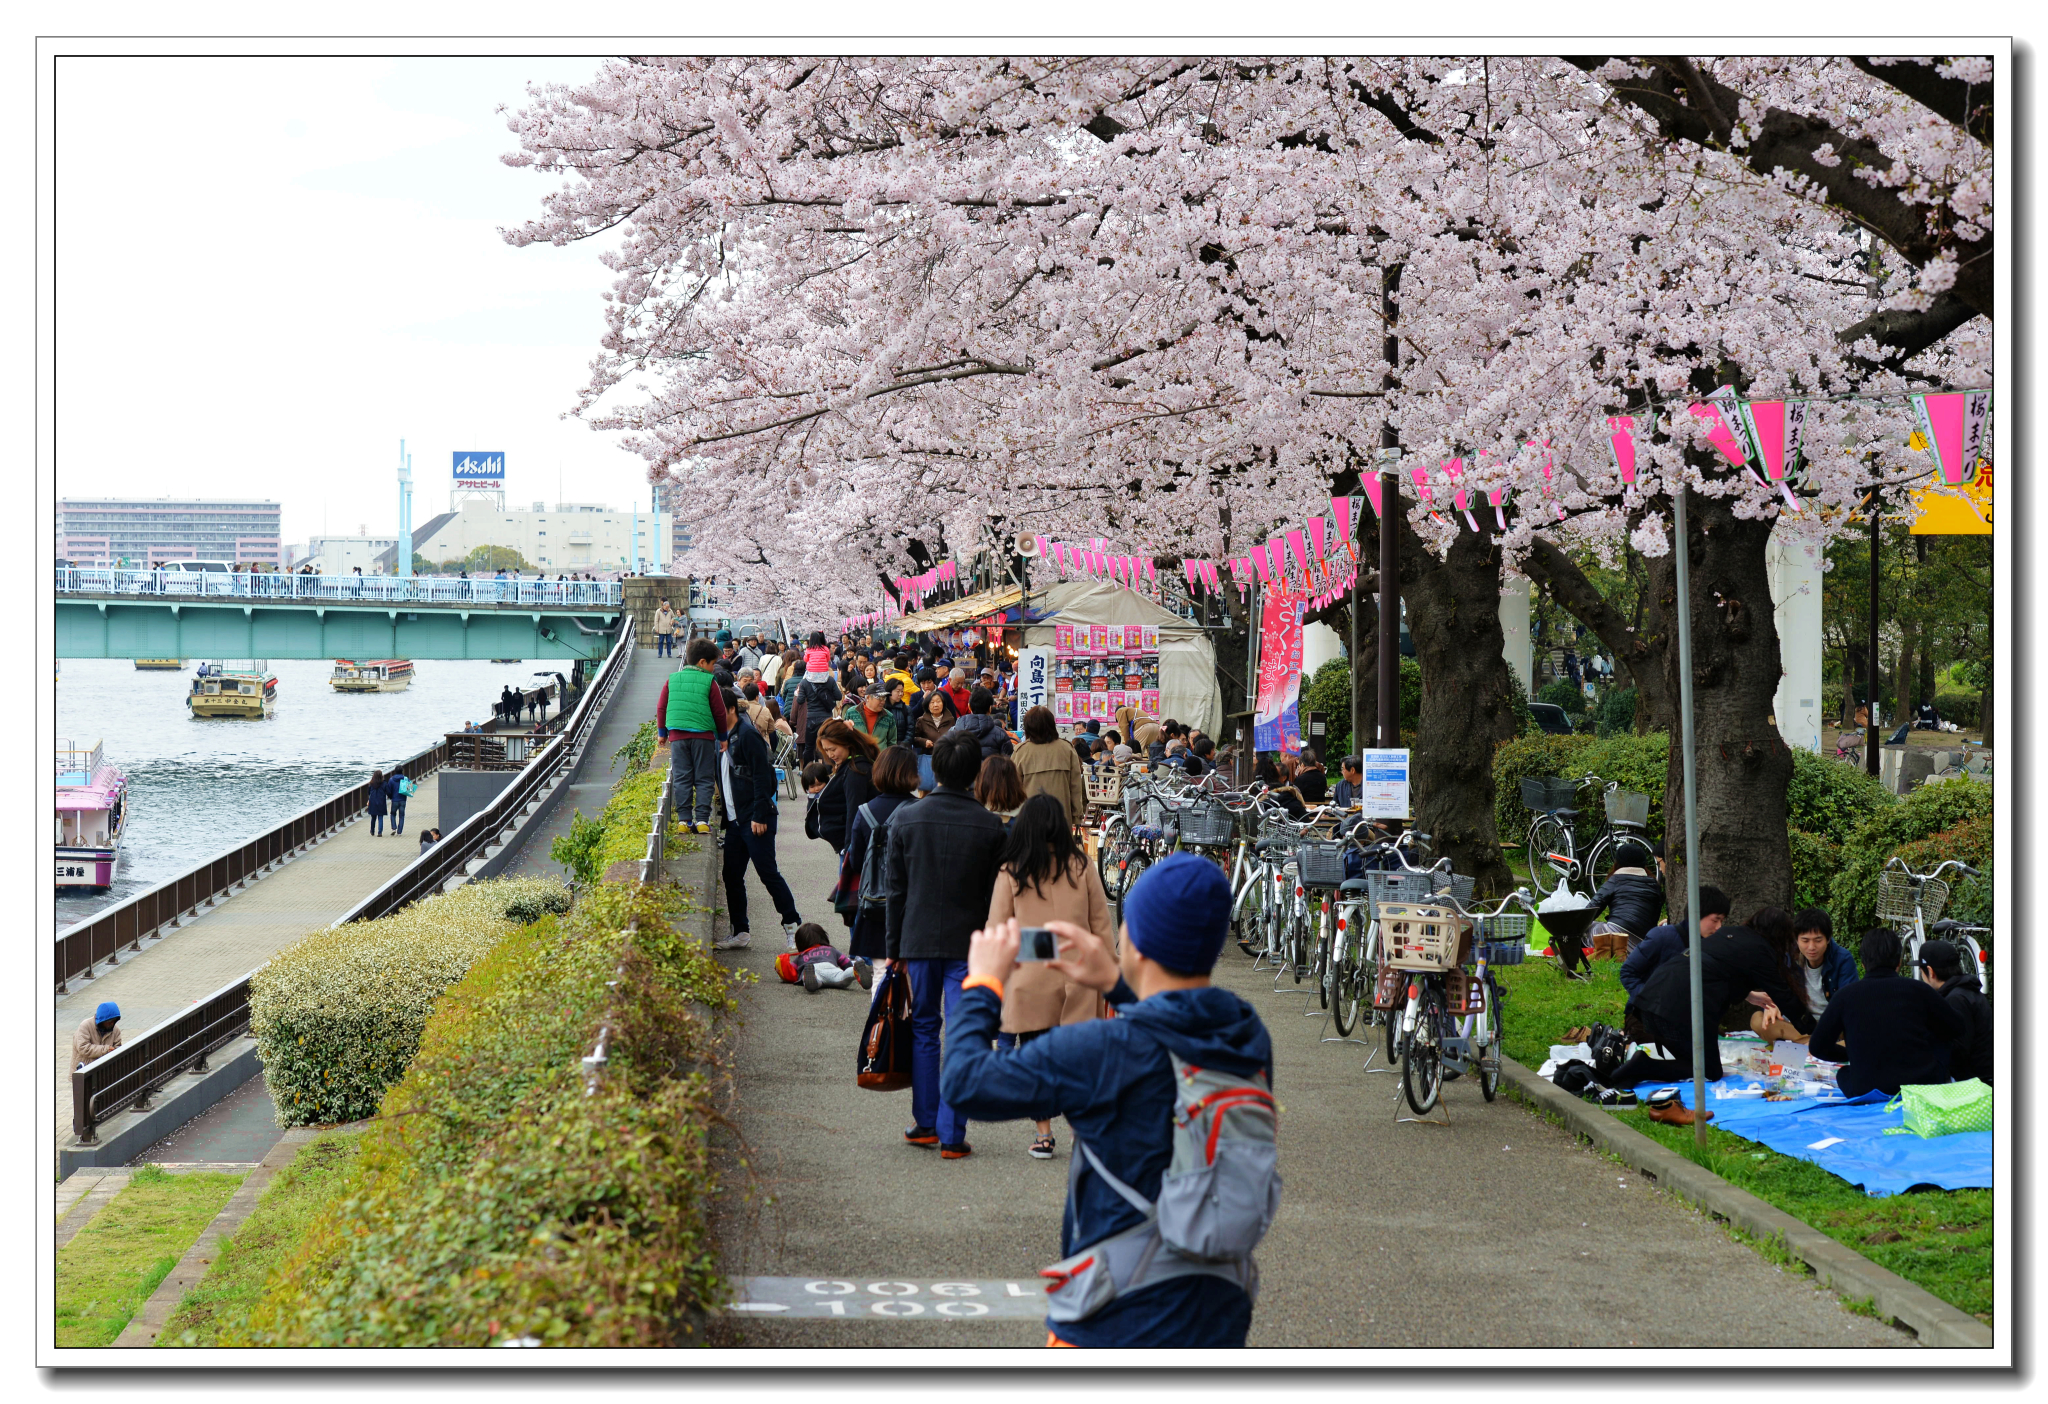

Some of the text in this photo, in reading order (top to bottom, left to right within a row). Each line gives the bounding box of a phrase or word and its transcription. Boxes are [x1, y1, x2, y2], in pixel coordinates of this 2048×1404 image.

[1785, 403, 1806, 478] 桜まつり
[1964, 393, 1987, 481] 桜まつり
[456, 455, 502, 475] Asahi
[457, 480, 501, 489] アサヒビール
[1349, 498, 1361, 540] 桜まつり
[1284, 542, 1292, 576] まつり
[1278, 598, 1296, 677] さくら
[1030, 655, 1045, 708] 向島一丁
[1261, 658, 1278, 717] まつり
[56, 867, 85, 878] 三浦屋
[1783, 1068, 1800, 1076] KOBE
[804, 1280, 1037, 1297] 1900
[815, 1300, 990, 1316] 100
